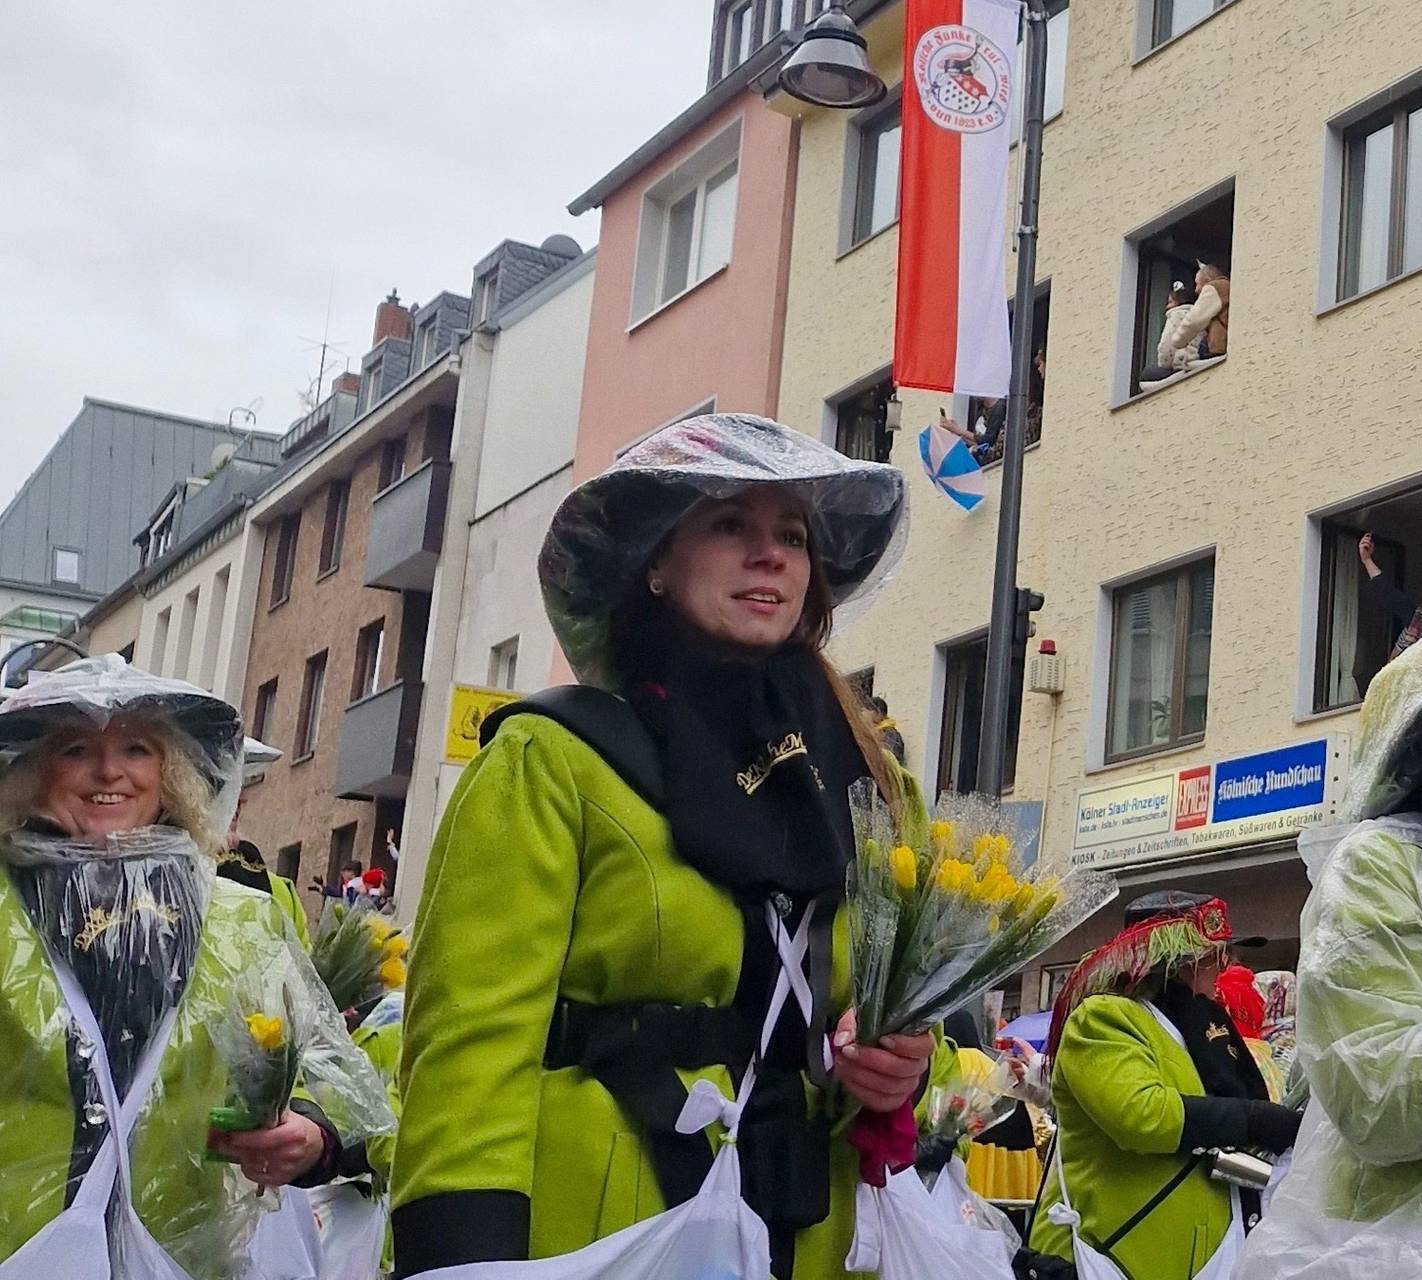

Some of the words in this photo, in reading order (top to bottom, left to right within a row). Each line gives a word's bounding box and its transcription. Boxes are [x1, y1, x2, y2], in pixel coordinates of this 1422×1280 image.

[934, 31, 971, 45] Funke
[1080, 806, 1106, 821] Kölner
[1108, 794, 1168, 816] Stadt-Anzeiger
[1072, 852, 1095, 865] KIOSK
[1102, 847, 1136, 861] Zeitungen
[1240, 819, 1277, 836] Süßwaren
[1286, 811, 1323, 828] Getränke
